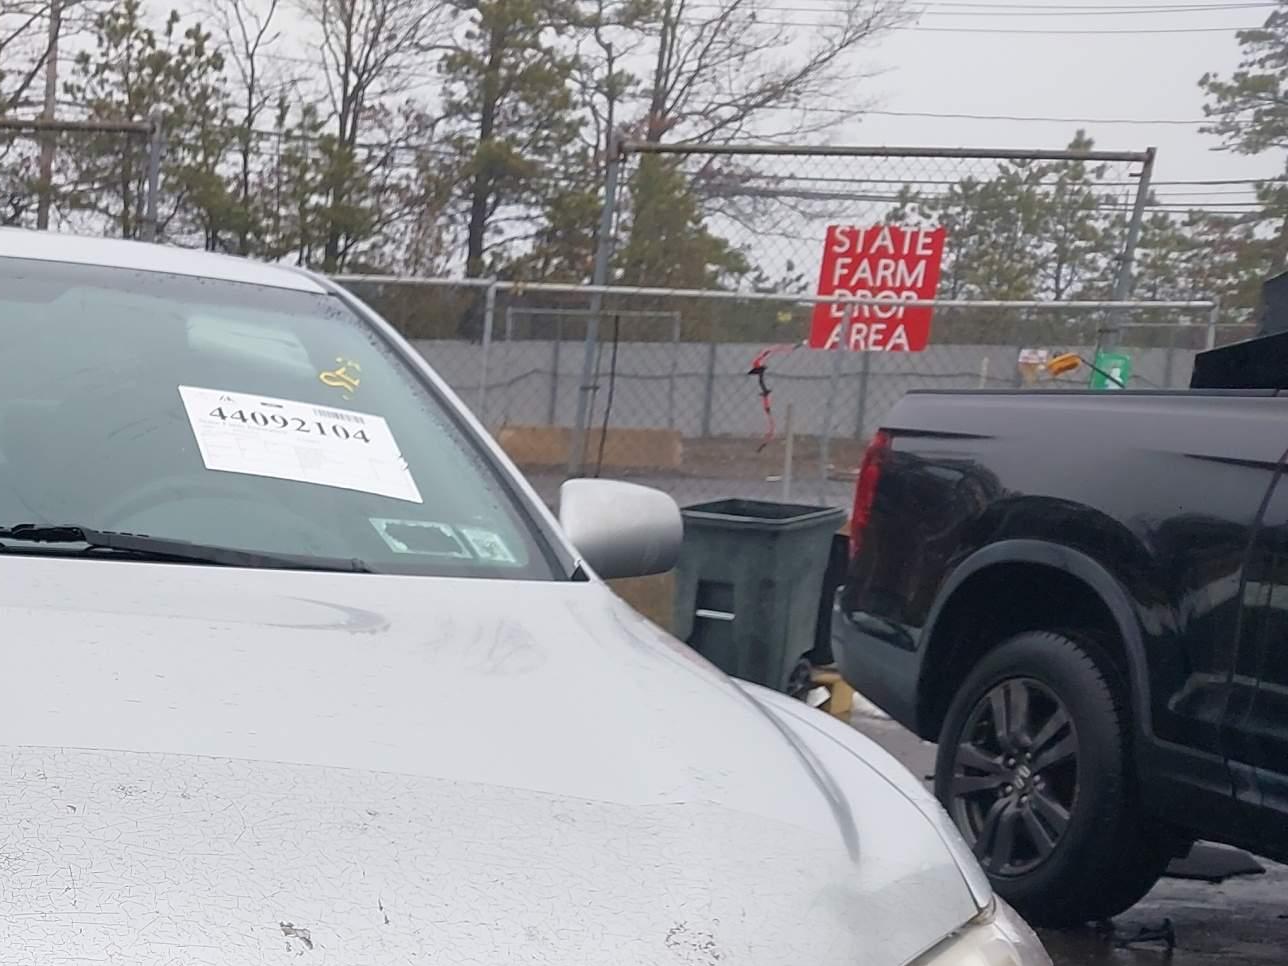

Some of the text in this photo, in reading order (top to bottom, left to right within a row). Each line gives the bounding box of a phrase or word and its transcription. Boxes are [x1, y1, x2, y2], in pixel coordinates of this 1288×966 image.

[832, 225, 936, 256] STATE
[832, 257, 927, 288] FARM
[829, 288, 919, 319] DROP
[823, 321, 911, 352] AREA
[208, 406, 371, 444] 44092104
